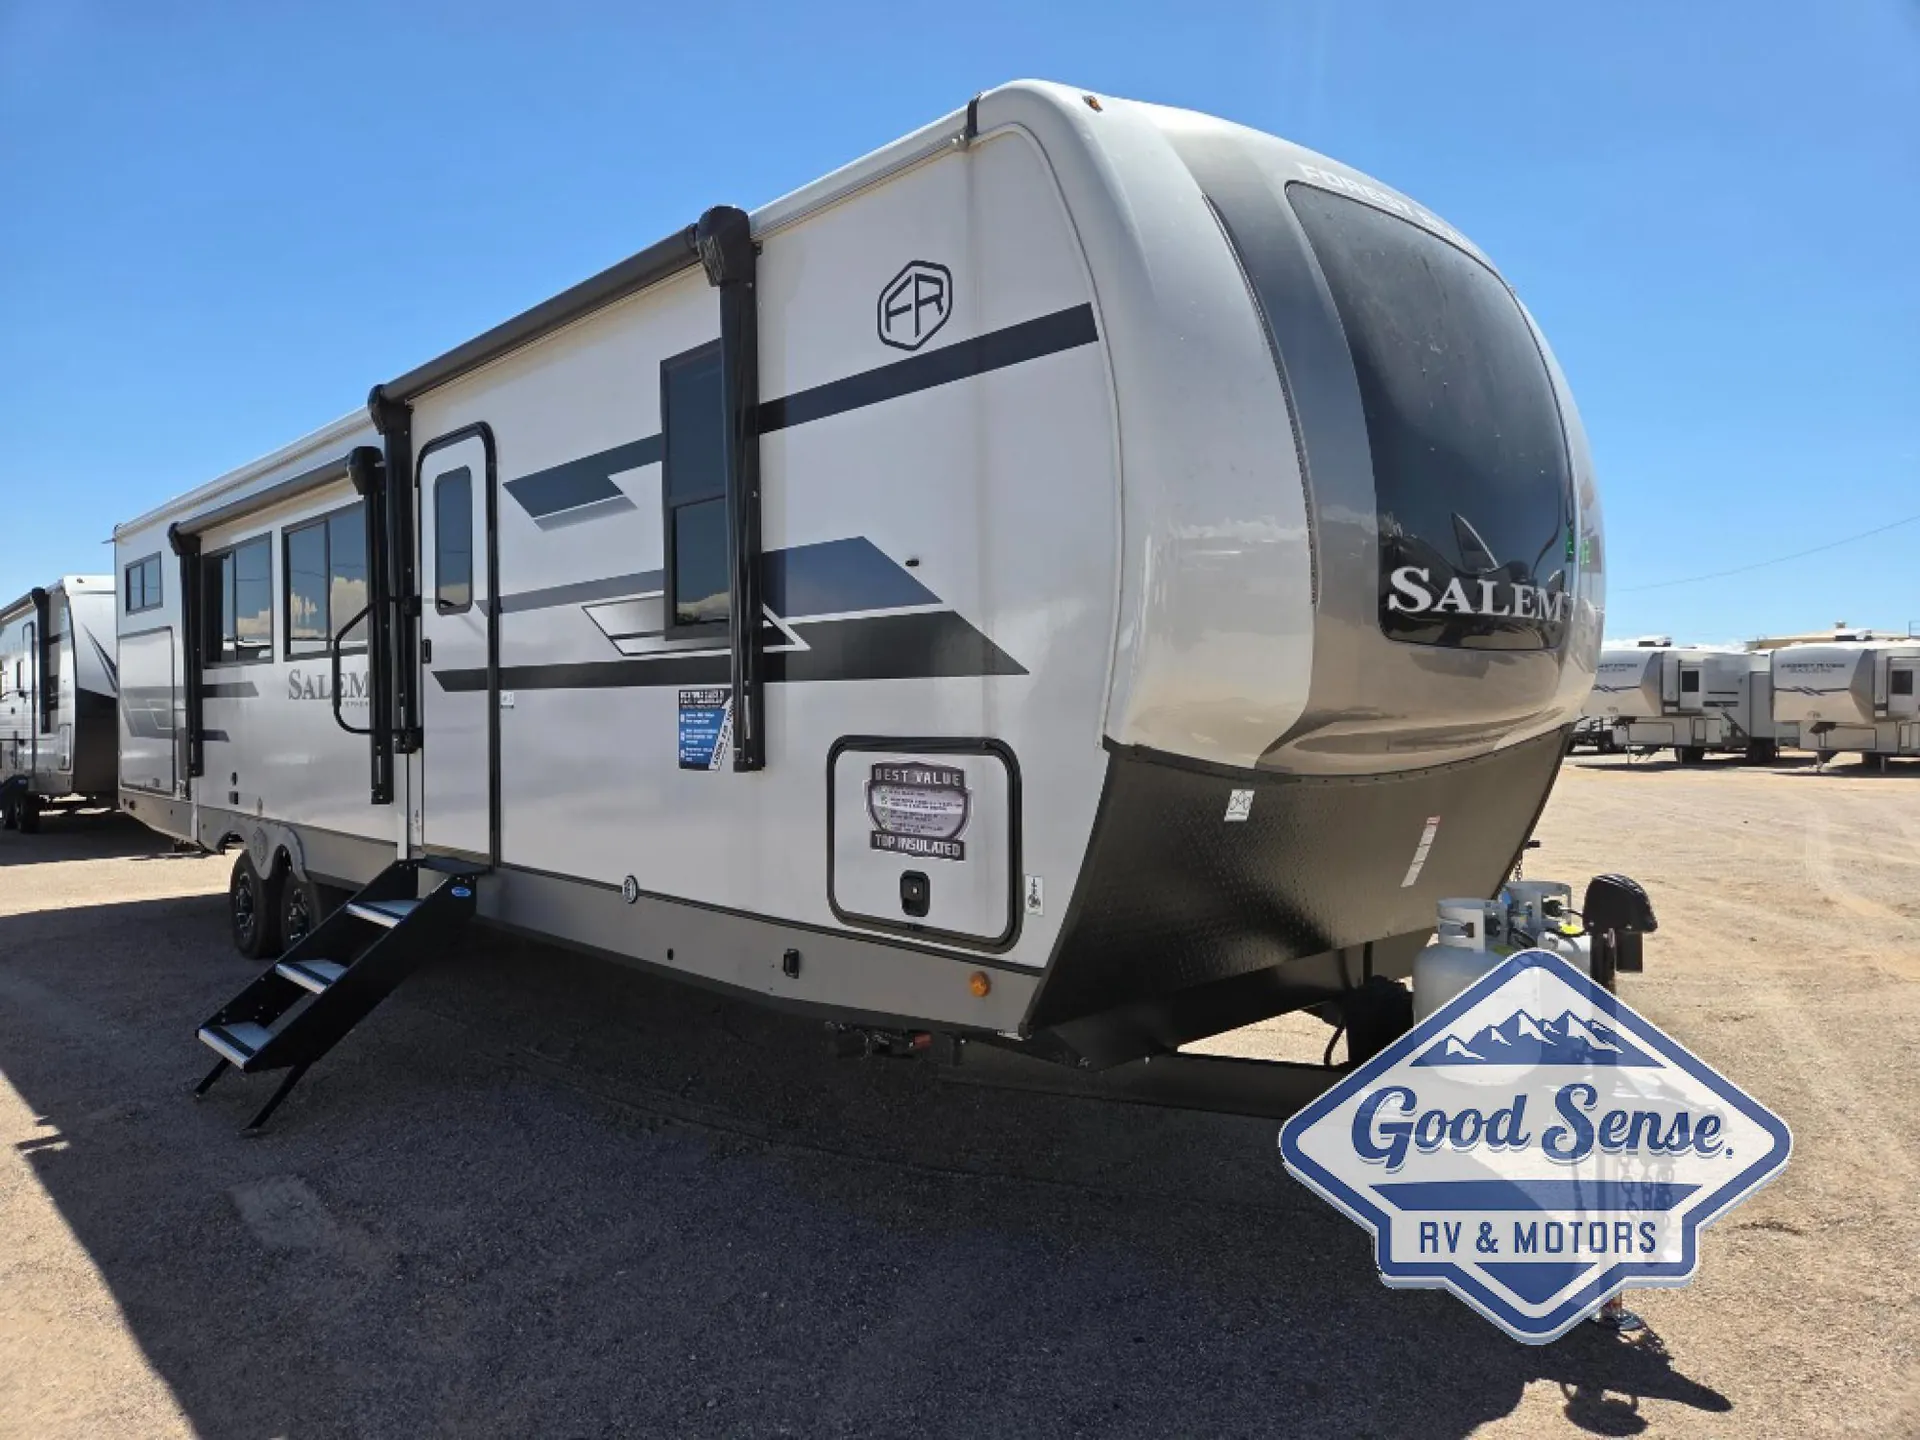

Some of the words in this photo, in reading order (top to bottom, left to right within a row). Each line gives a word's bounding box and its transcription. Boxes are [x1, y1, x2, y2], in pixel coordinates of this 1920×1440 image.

[885, 272, 943, 337] FR
[1388, 566, 1566, 622] SALEM
[875, 768, 908, 783] BEST
[915, 771, 961, 787] VALUE
[897, 838, 961, 857] INSULATED
